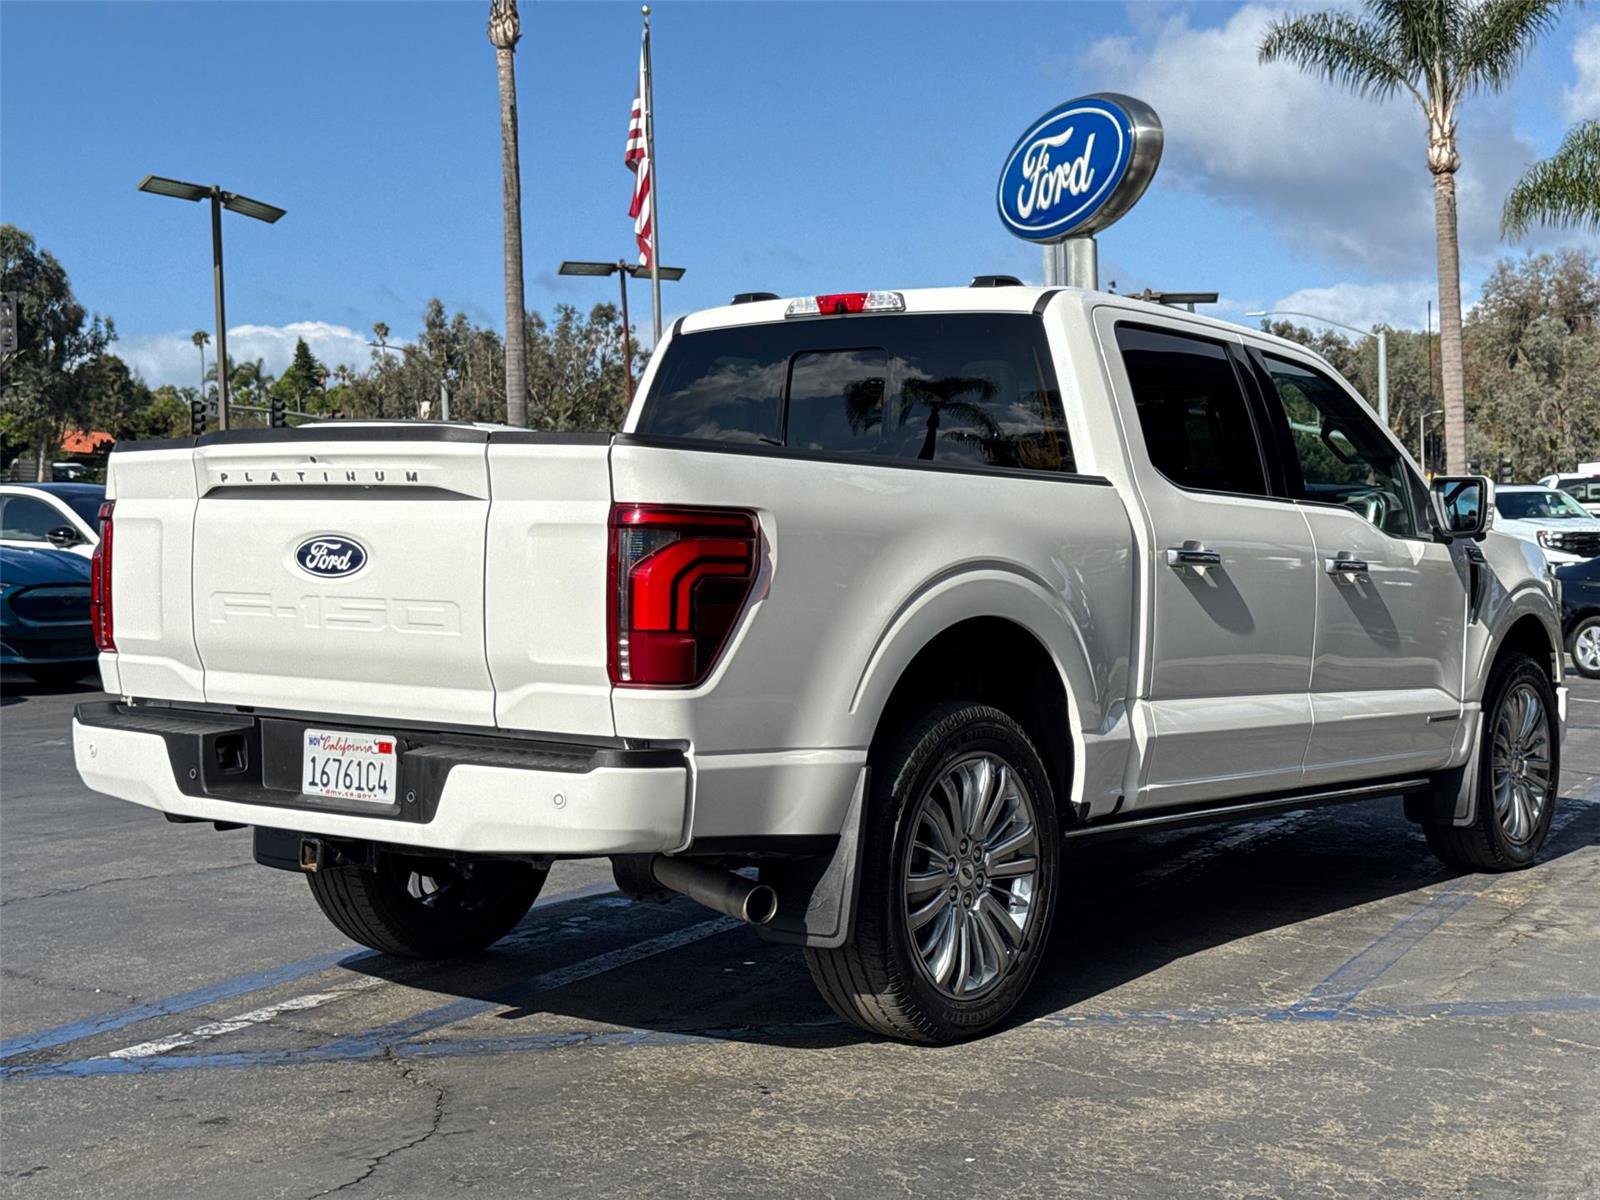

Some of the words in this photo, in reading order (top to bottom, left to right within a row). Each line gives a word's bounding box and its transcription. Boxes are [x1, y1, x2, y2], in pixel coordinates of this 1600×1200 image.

[1017, 126, 1096, 219] Ford
[220, 471, 418, 483] PLATINUM
[305, 541, 353, 570] Ford
[209, 590, 462, 637] F-150
[322, 735, 374, 757] California
[308, 755, 388, 794] 16761C4
